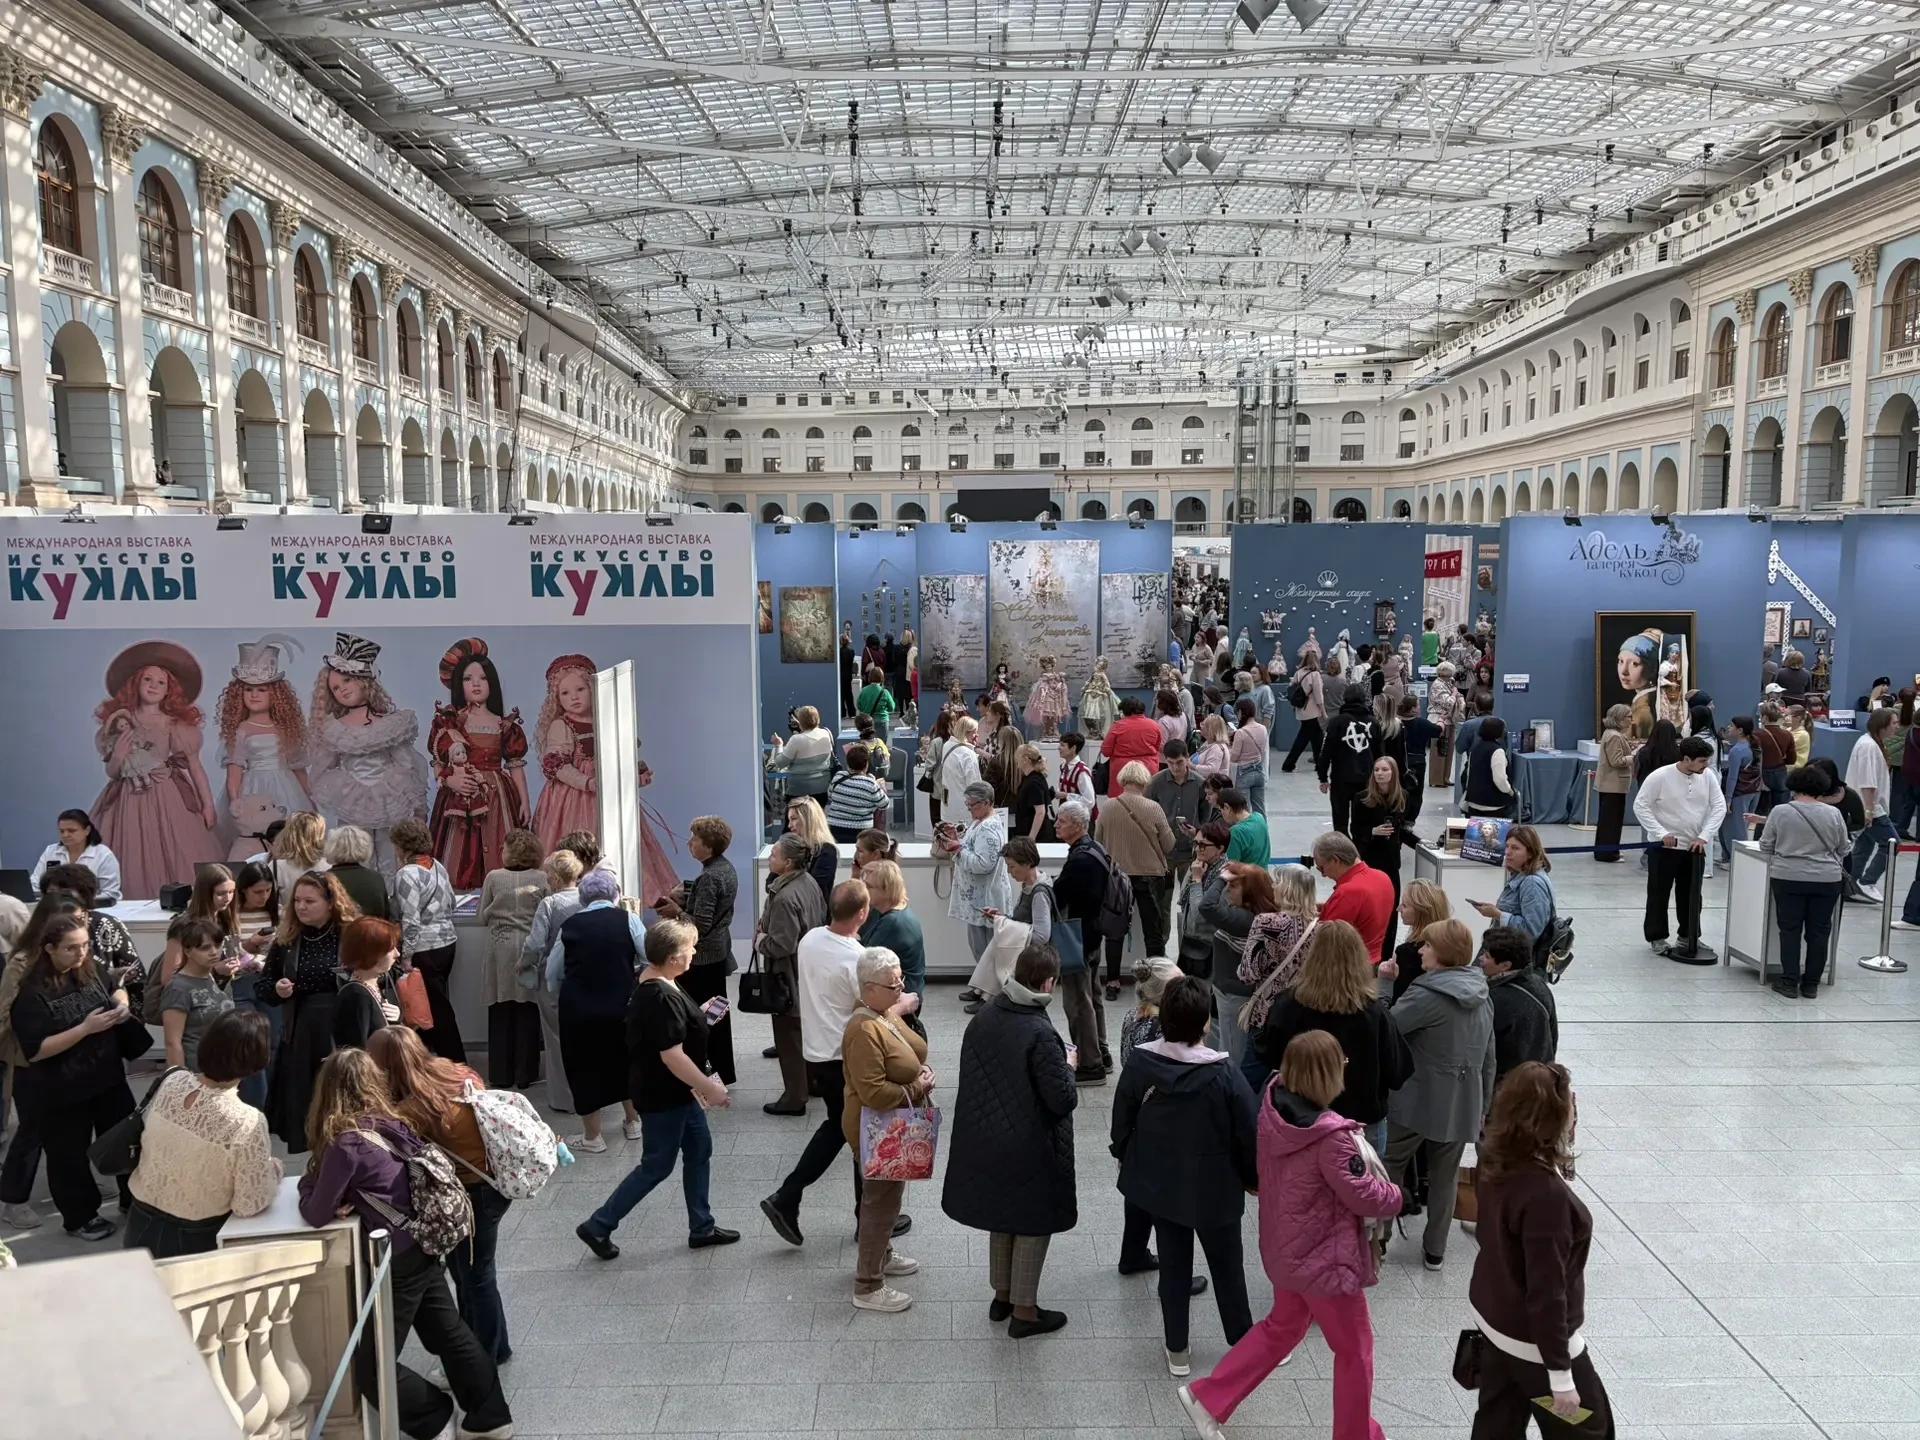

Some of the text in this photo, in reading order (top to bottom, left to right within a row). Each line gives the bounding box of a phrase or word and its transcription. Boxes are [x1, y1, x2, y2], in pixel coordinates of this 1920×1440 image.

[7, 536, 192, 548] МЕЖДУНАРОДНАЯ ВЫСТАВКА
[271, 535, 453, 547] МЕЖДУНАРОДНАЯ ВЫСТАВКА
[529, 533, 711, 546] МЕЖДУНАРОДНАЯ ВЫСТАВКА
[8, 553, 194, 566] ИСКУССТВО
[272, 551, 455, 564] ИСКУССТВО
[531, 550, 713, 562] ИСКУССТВО
